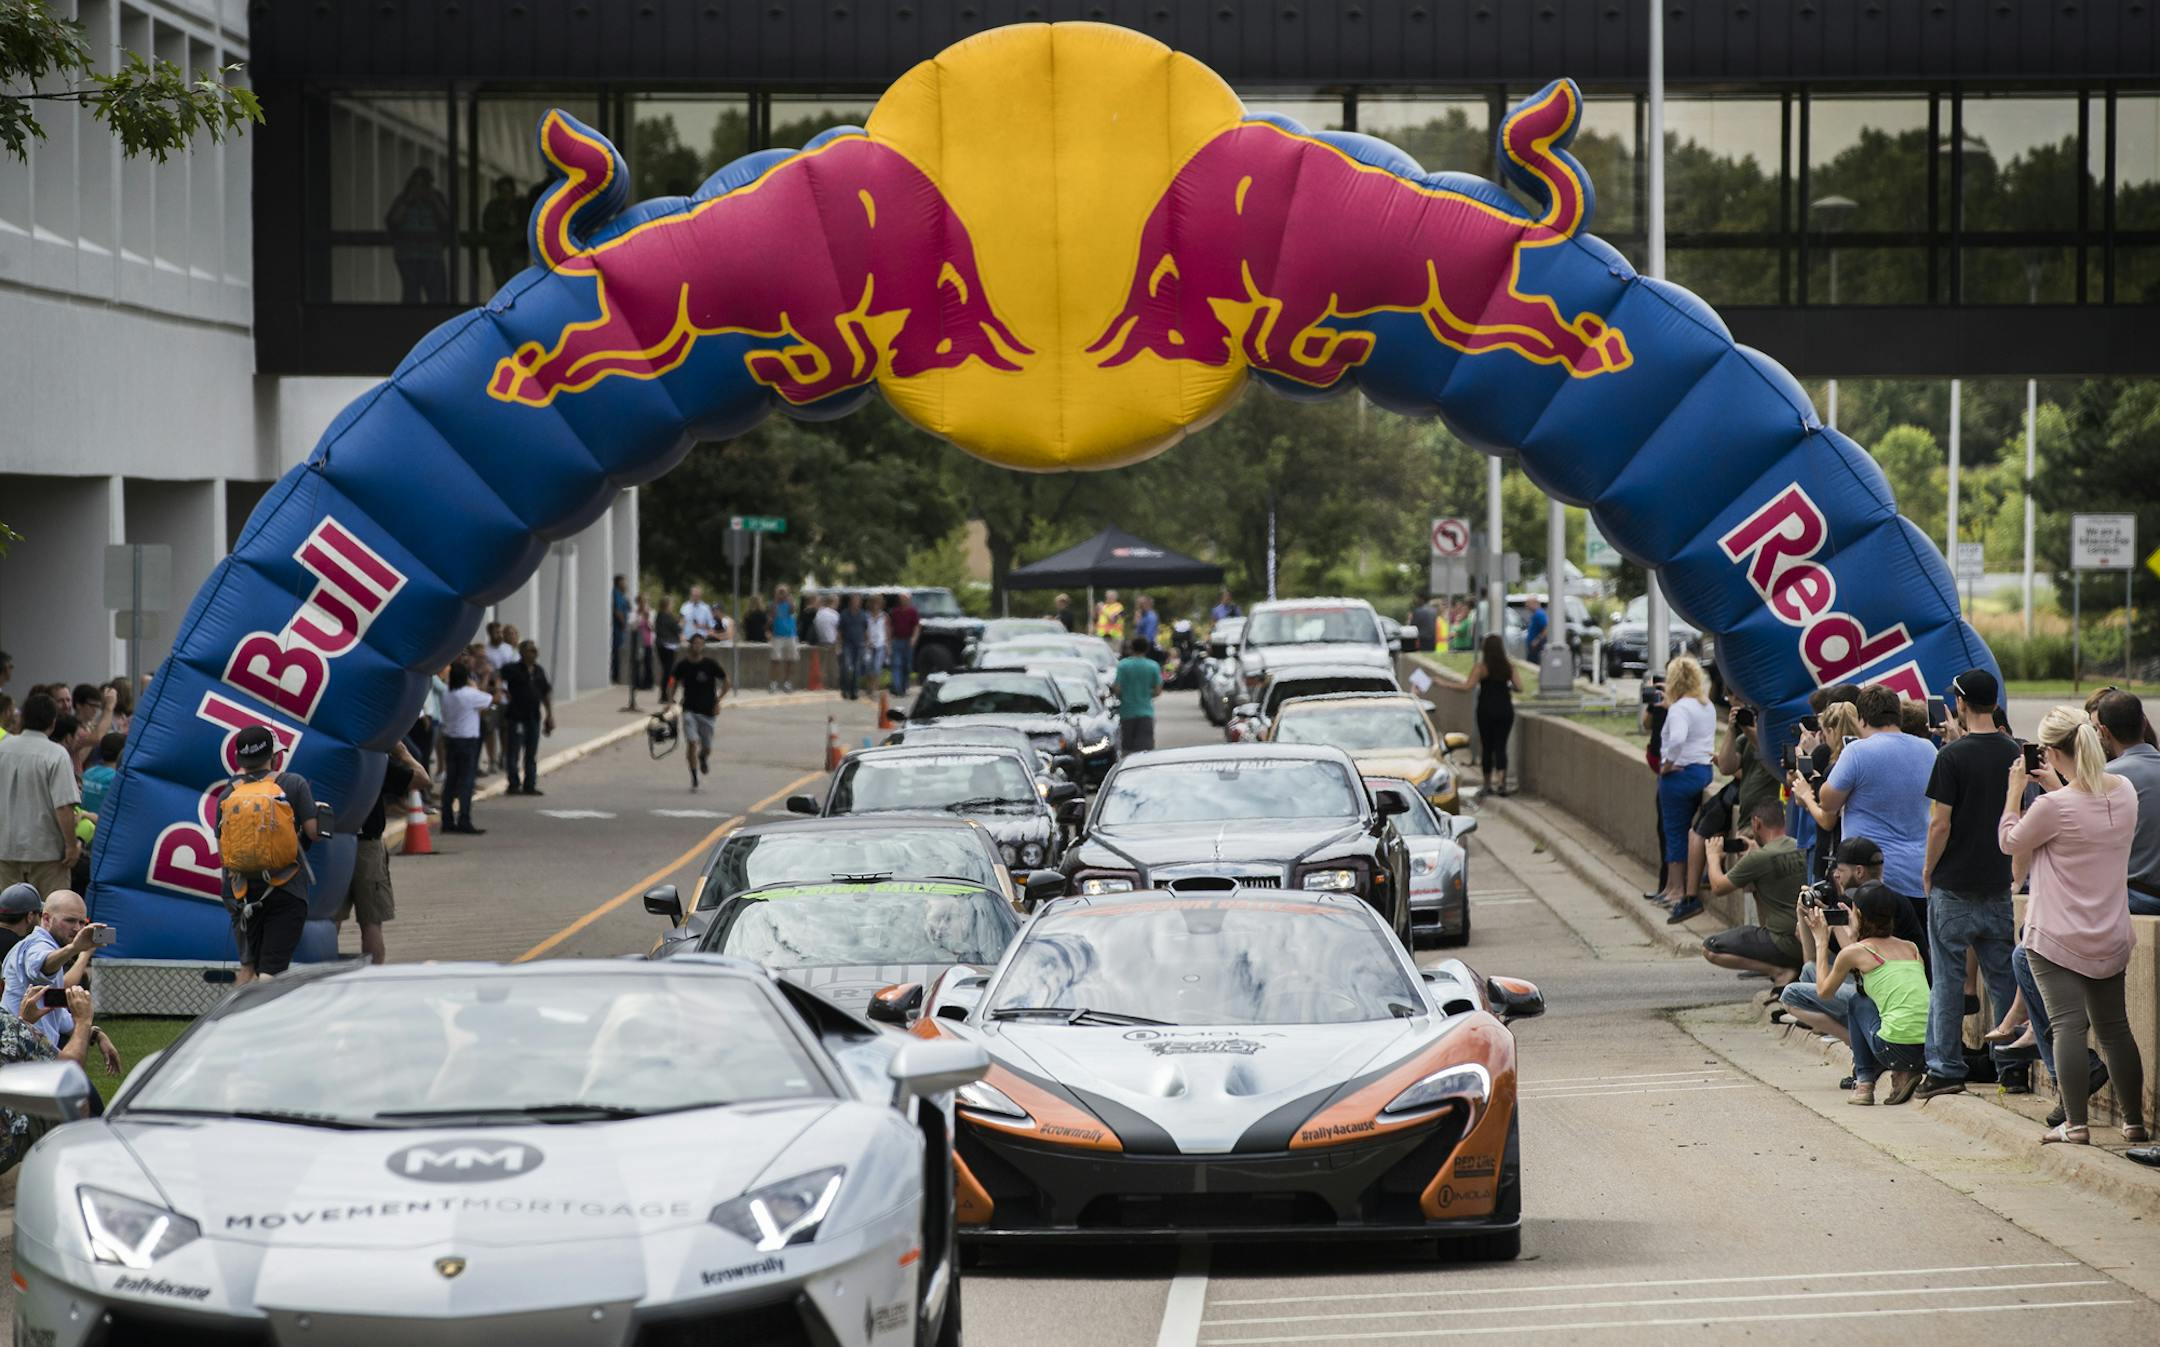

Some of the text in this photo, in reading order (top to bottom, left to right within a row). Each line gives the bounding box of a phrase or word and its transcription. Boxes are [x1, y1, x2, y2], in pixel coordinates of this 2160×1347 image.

[1717, 481, 1914, 688] Red
[146, 514, 408, 900] Rd Bull
[1040, 1124, 1104, 1143] #crownrally
[1302, 1120, 1375, 1142] #rally4acause
